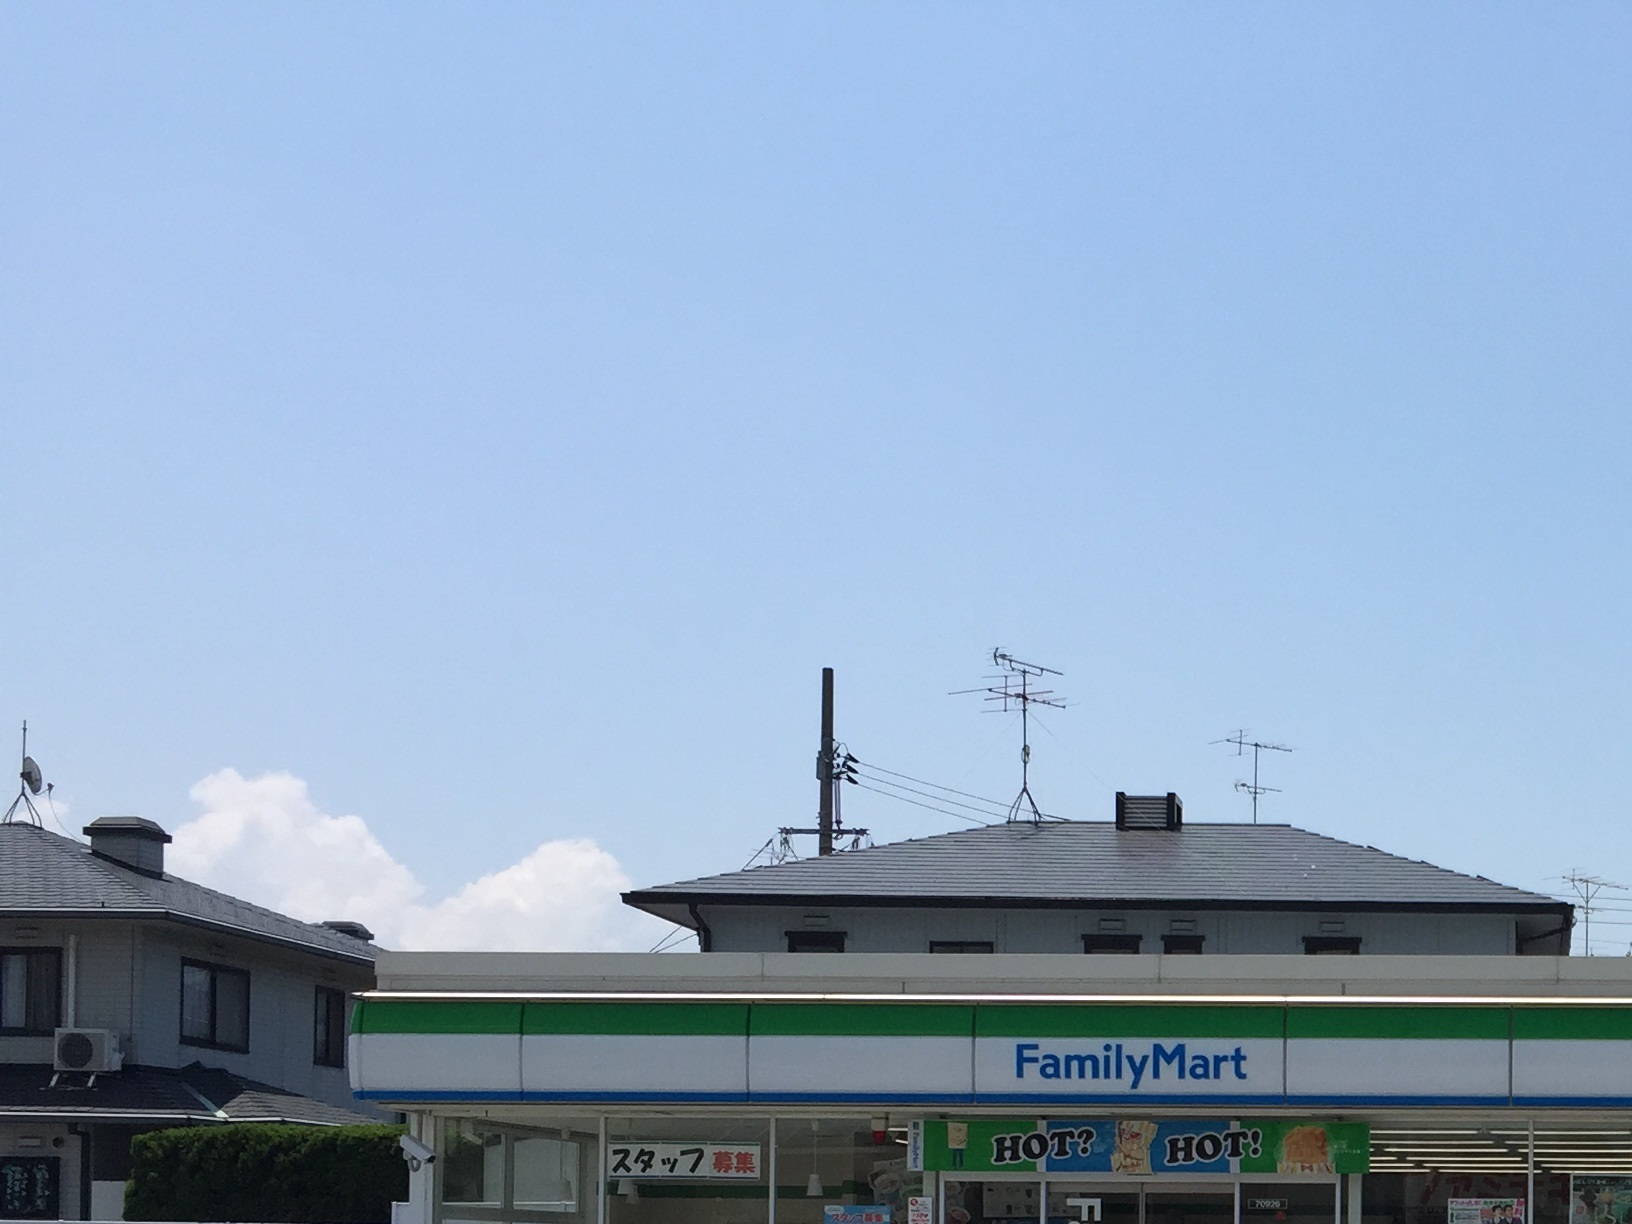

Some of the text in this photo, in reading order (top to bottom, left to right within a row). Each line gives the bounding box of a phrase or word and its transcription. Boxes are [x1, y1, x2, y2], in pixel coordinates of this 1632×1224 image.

[1015, 1043, 1247, 1089] FamilyMart
[611, 1147, 756, 1175] スタッフ募集
[993, 1128, 1093, 1164] HOT?
[1166, 1126, 1261, 1164] HOT!
